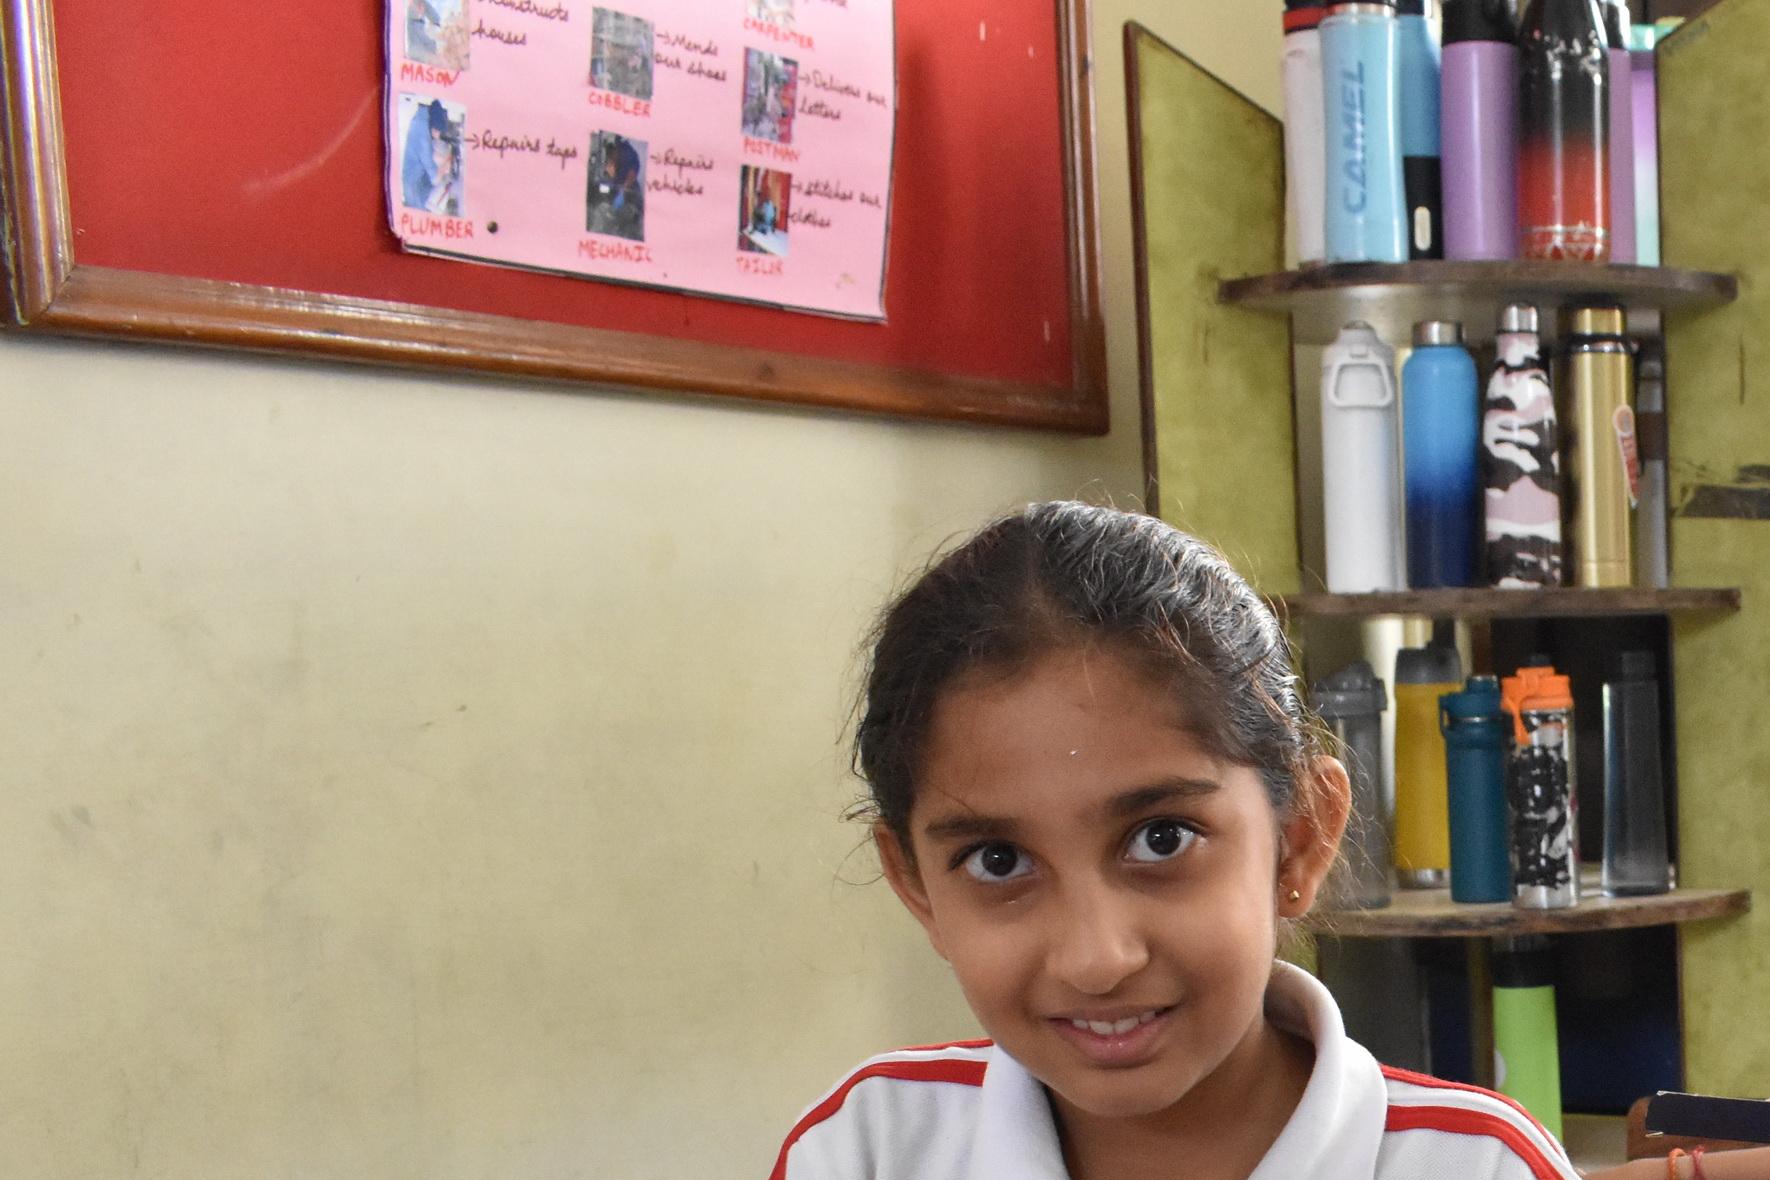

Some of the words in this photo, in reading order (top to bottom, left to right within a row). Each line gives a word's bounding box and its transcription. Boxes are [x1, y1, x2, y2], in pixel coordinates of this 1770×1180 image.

[401, 62, 461, 87] MASON
[1342, 60, 1365, 215] CAMEL
[401, 212, 475, 240] PLUMBER
